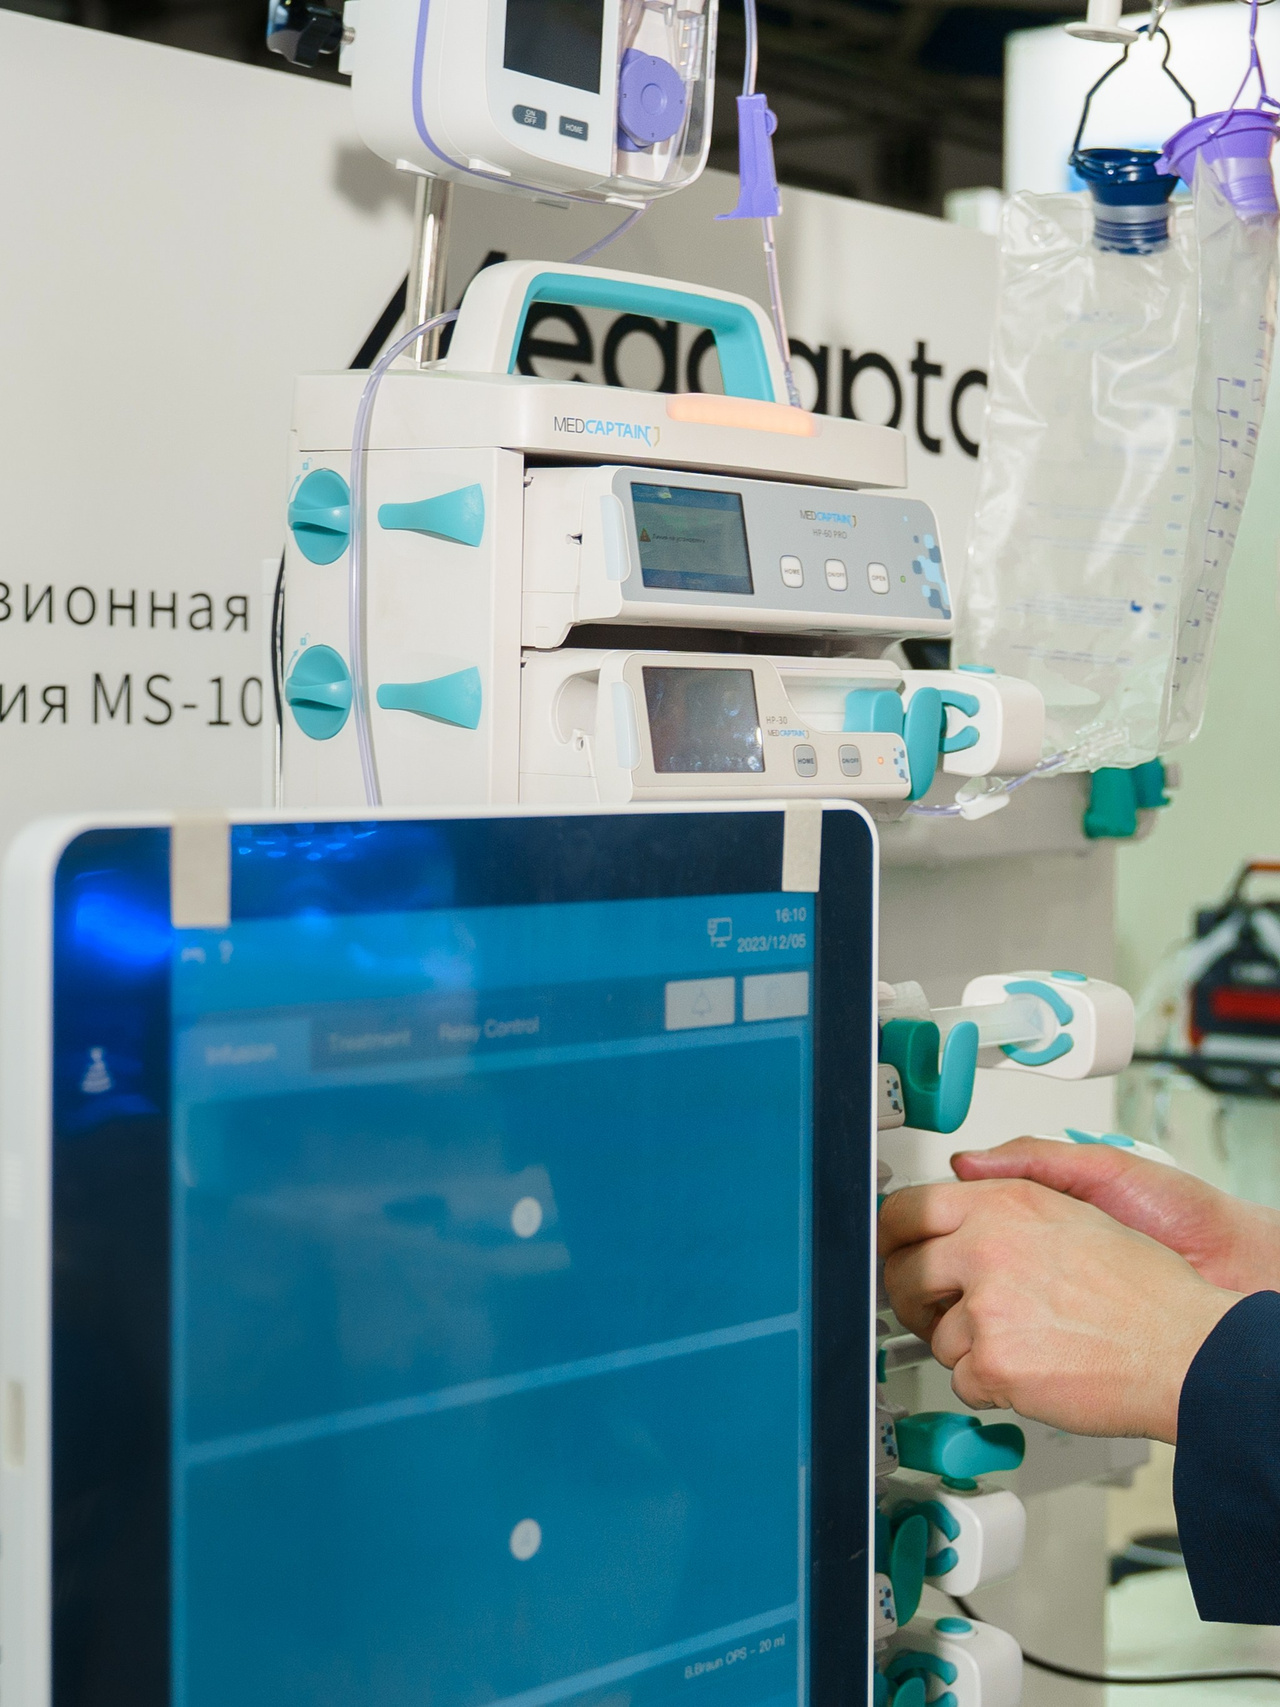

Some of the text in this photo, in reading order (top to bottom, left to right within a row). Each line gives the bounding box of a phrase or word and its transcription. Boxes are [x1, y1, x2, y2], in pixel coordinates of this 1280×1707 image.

[525, 109, 536, 117] ON
[524, 117, 537, 125] OFF
[565, 123, 584, 134] HOME
[554, 416, 653, 447] MEDCAPTAIN
[834, 529, 848, 539] PRO
[766, 716, 788, 725] HP-30
[775, 906, 807, 923] 16:10
[737, 933, 807, 953] 2023/12/05
[484, 1016, 541, 1039] Control
[759, 1638, 772, 1654] 20
